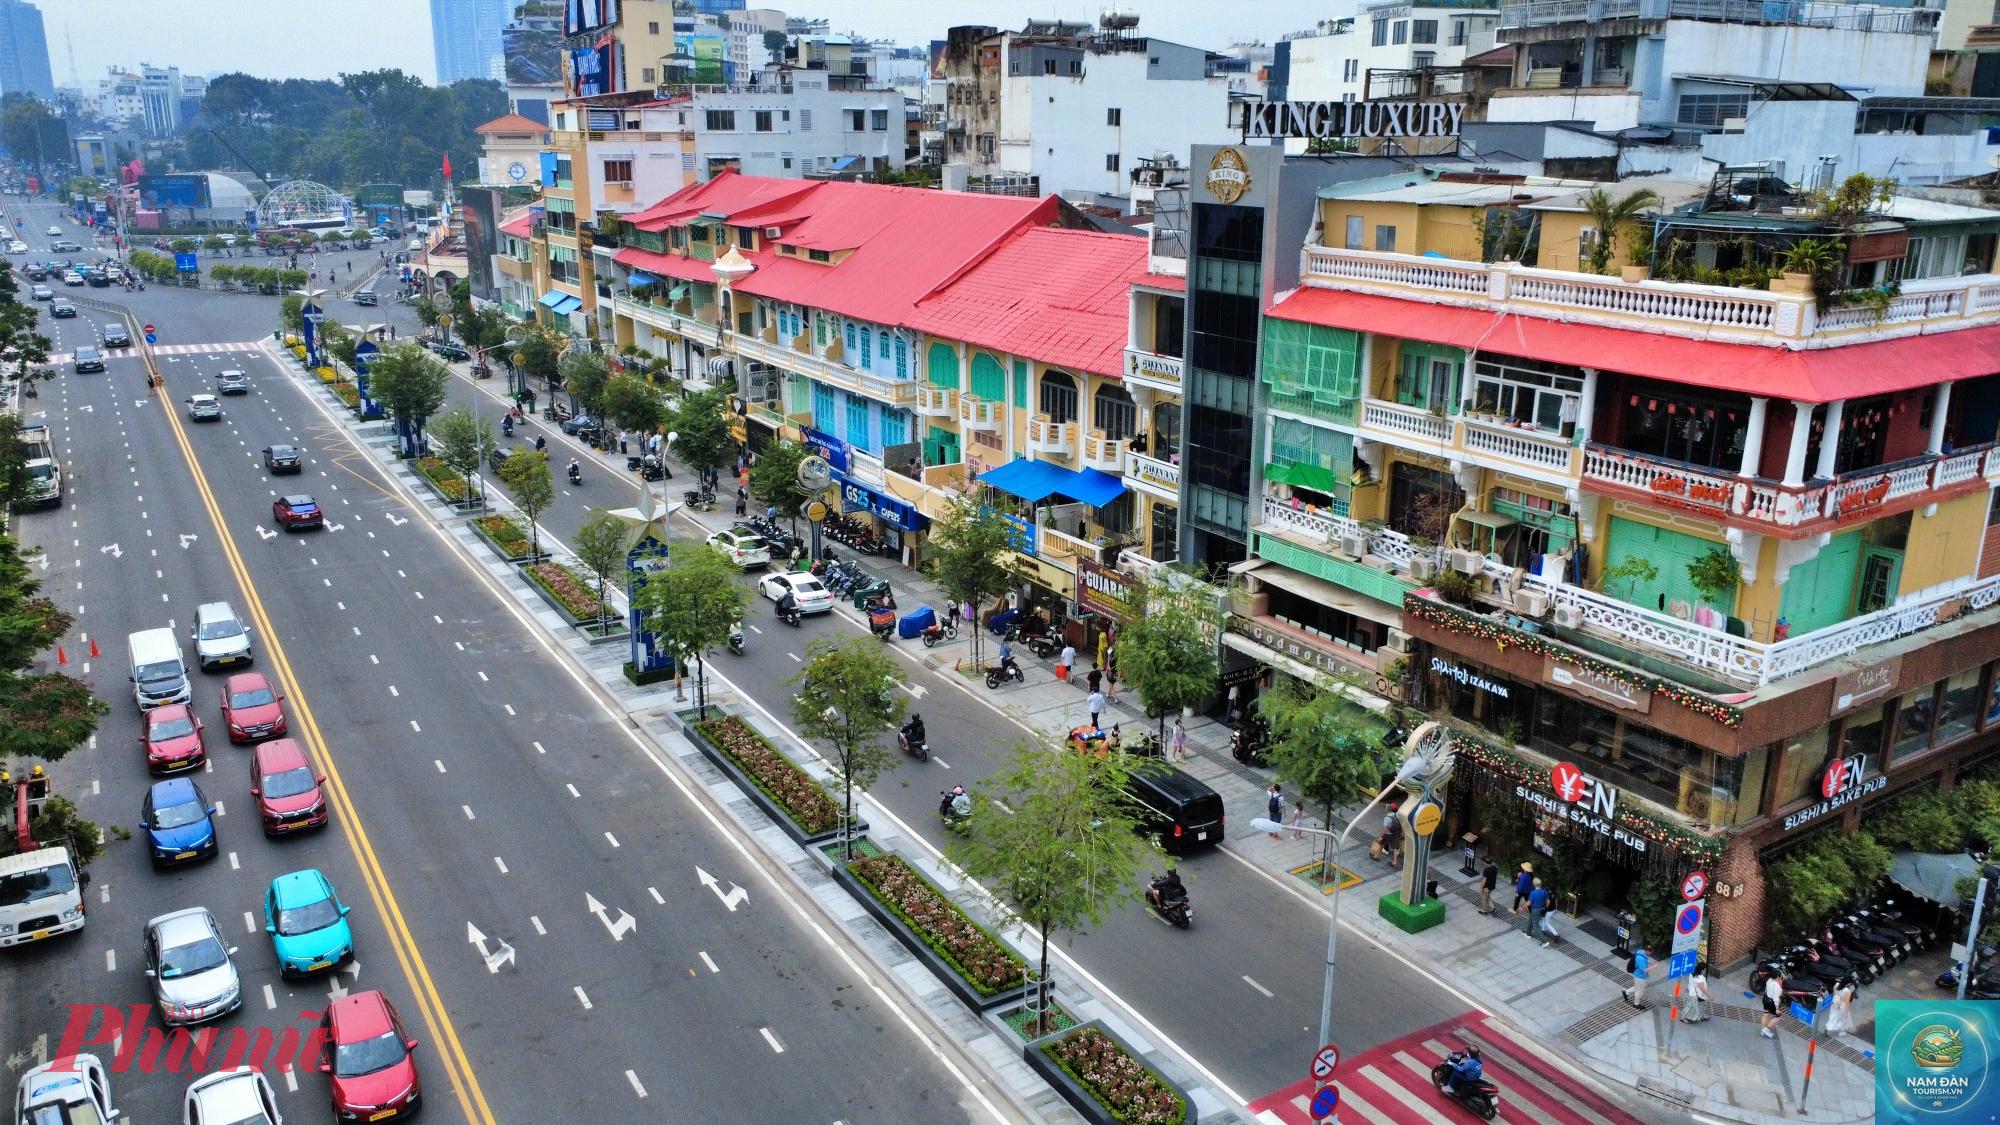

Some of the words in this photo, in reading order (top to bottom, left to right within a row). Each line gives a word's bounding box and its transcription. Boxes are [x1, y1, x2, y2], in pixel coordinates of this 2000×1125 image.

[1248, 101, 1332, 138] KING
[1341, 102, 1467, 137] LUXURY
[1214, 171, 1240, 181] KING
[1142, 360, 1180, 376] GUJARAT
[846, 485, 869, 508] GS25
[881, 508, 901, 522] CAFE25
[1469, 675, 1508, 698] IZAKAYA
[1784, 806, 1820, 831] SUSHI
[1831, 787, 1863, 810] SAKE
[1863, 776, 1887, 796] PUB
[1516, 786, 1556, 813] SUSHI
[1570, 810, 1611, 836] SAKE
[1614, 829, 1646, 852] PUB
[1716, 881, 1731, 897] 68
[1734, 883, 1744, 898] 68
